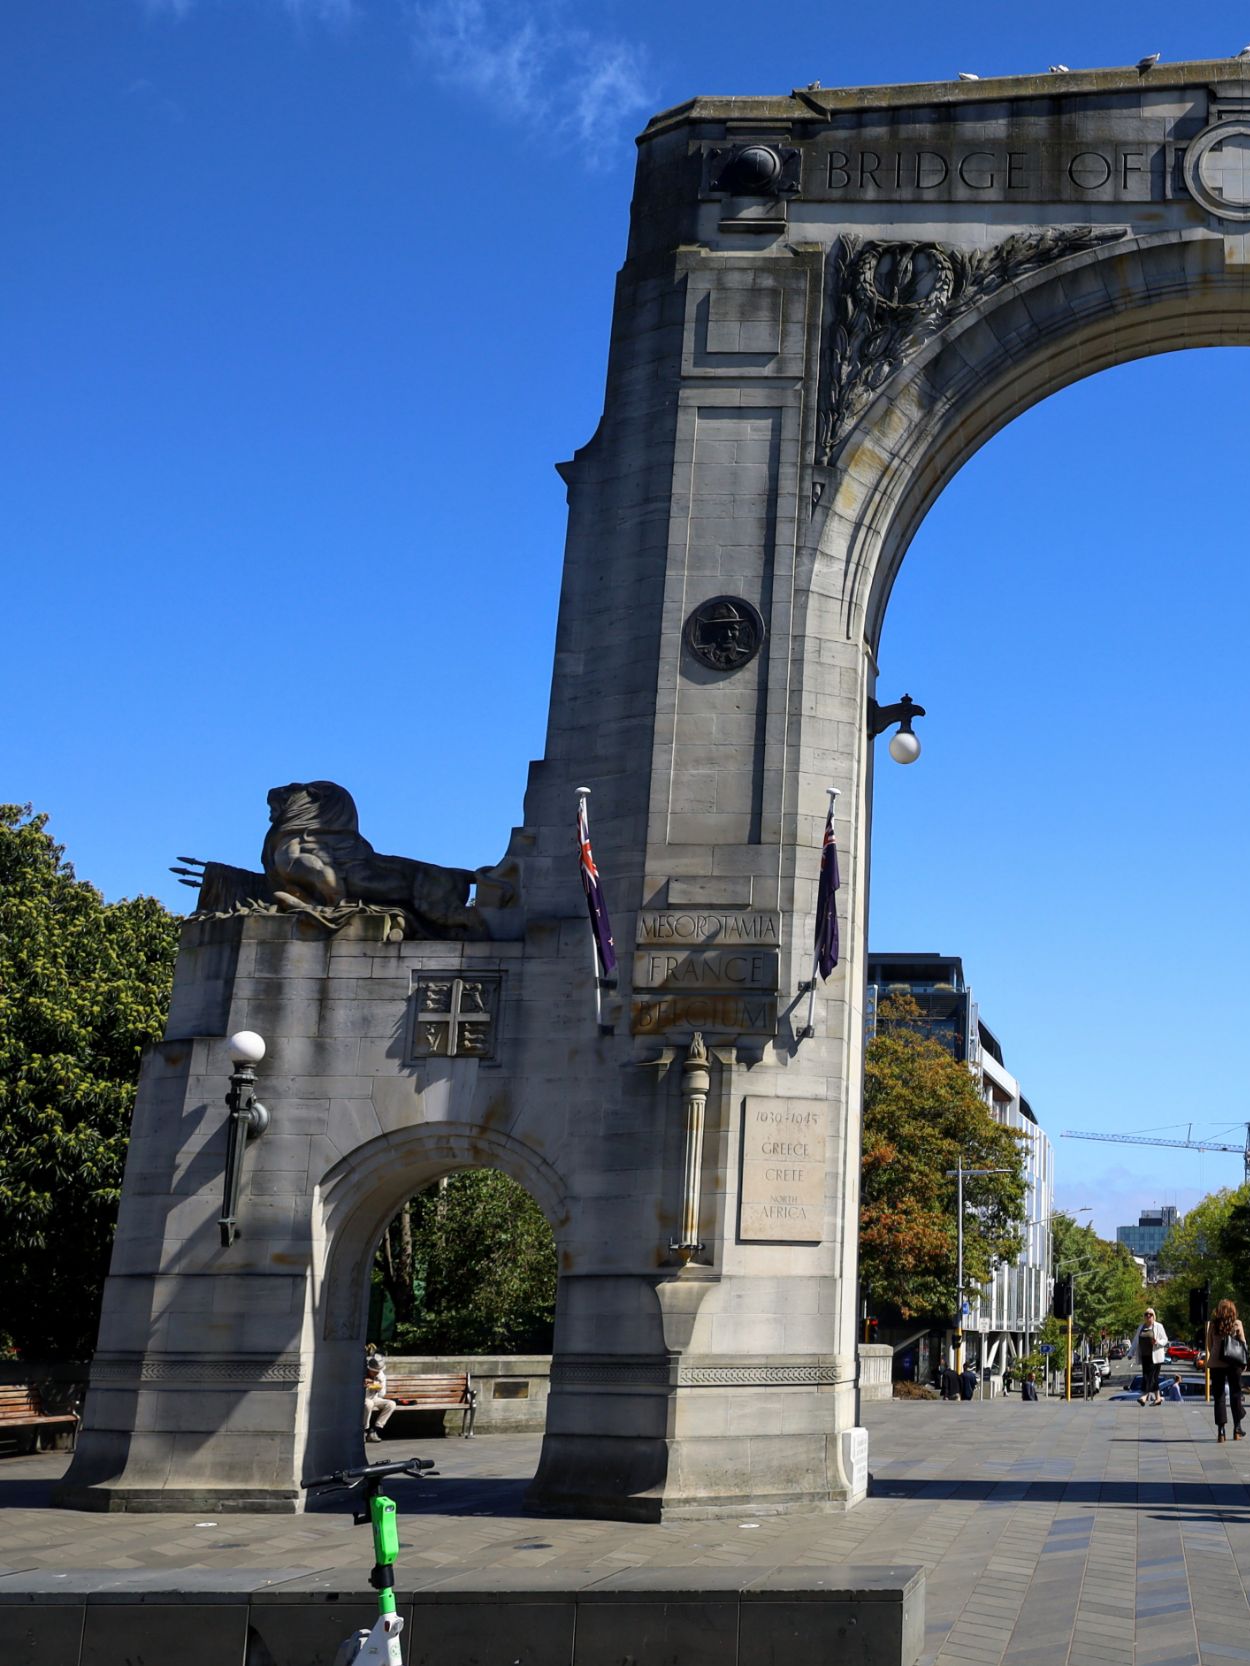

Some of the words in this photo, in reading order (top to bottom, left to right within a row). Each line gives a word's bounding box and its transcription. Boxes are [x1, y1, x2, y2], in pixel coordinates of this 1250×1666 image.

[825, 149, 1028, 191] BRIDGE
[1067, 150, 1143, 191] OF
[640, 914, 777, 939] MESOPOTAMIA
[649, 956, 763, 983] FRANCE
[639, 1000, 767, 1029] BELGIUM
[761, 1142, 809, 1157] GREECE
[765, 1168, 805, 1182] CRETE
[760, 1205, 807, 1220] AFRICA
